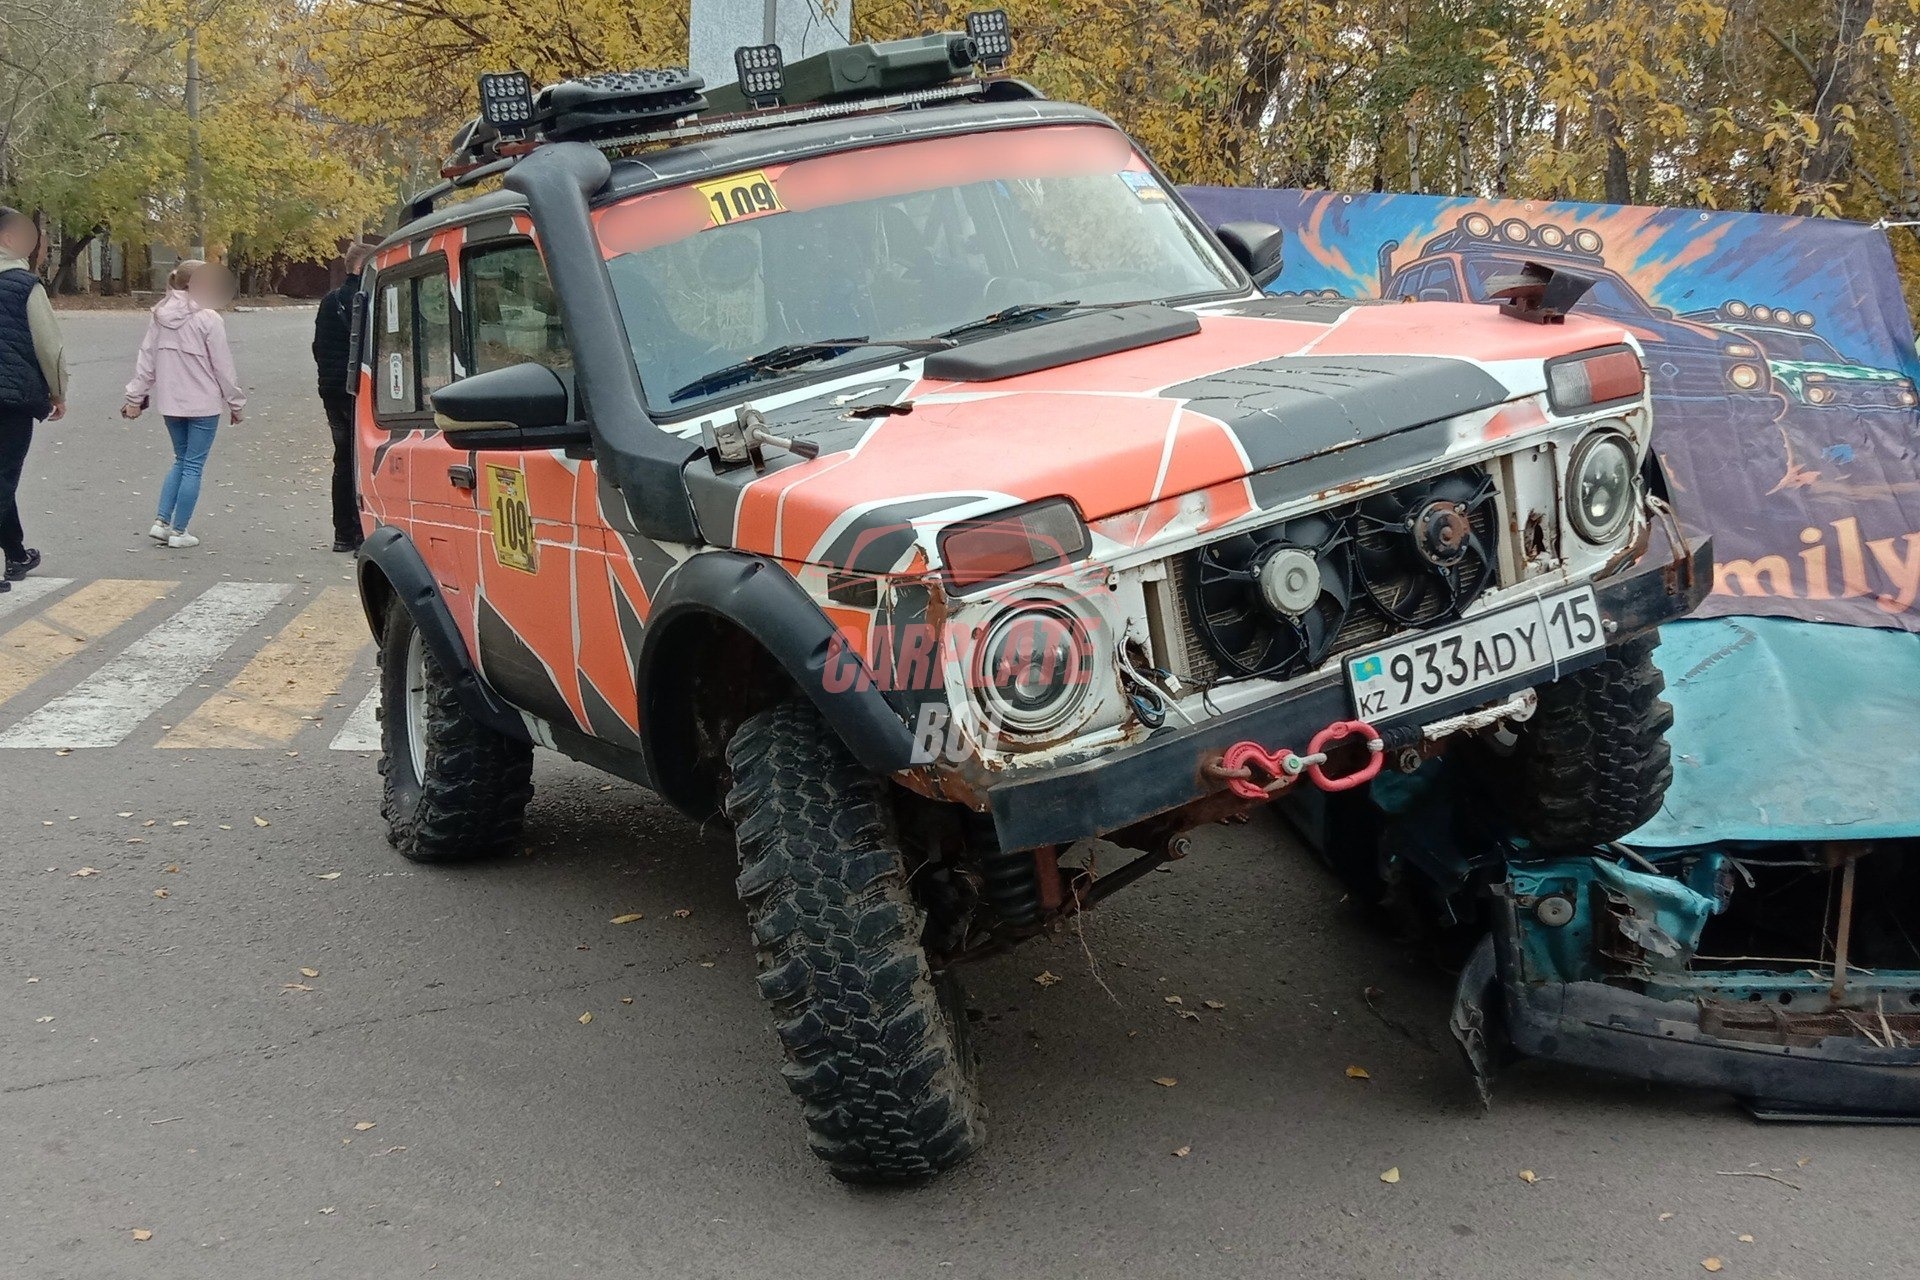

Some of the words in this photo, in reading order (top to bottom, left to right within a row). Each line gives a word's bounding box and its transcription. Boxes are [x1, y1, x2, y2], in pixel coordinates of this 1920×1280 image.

[711, 182, 776, 222] 109
[496, 496, 529, 556] 109
[1713, 516, 1920, 614] mily
[1390, 621, 1537, 705] 933ADY
[1549, 593, 1596, 649] 15
[1358, 689, 1388, 718] KZ
